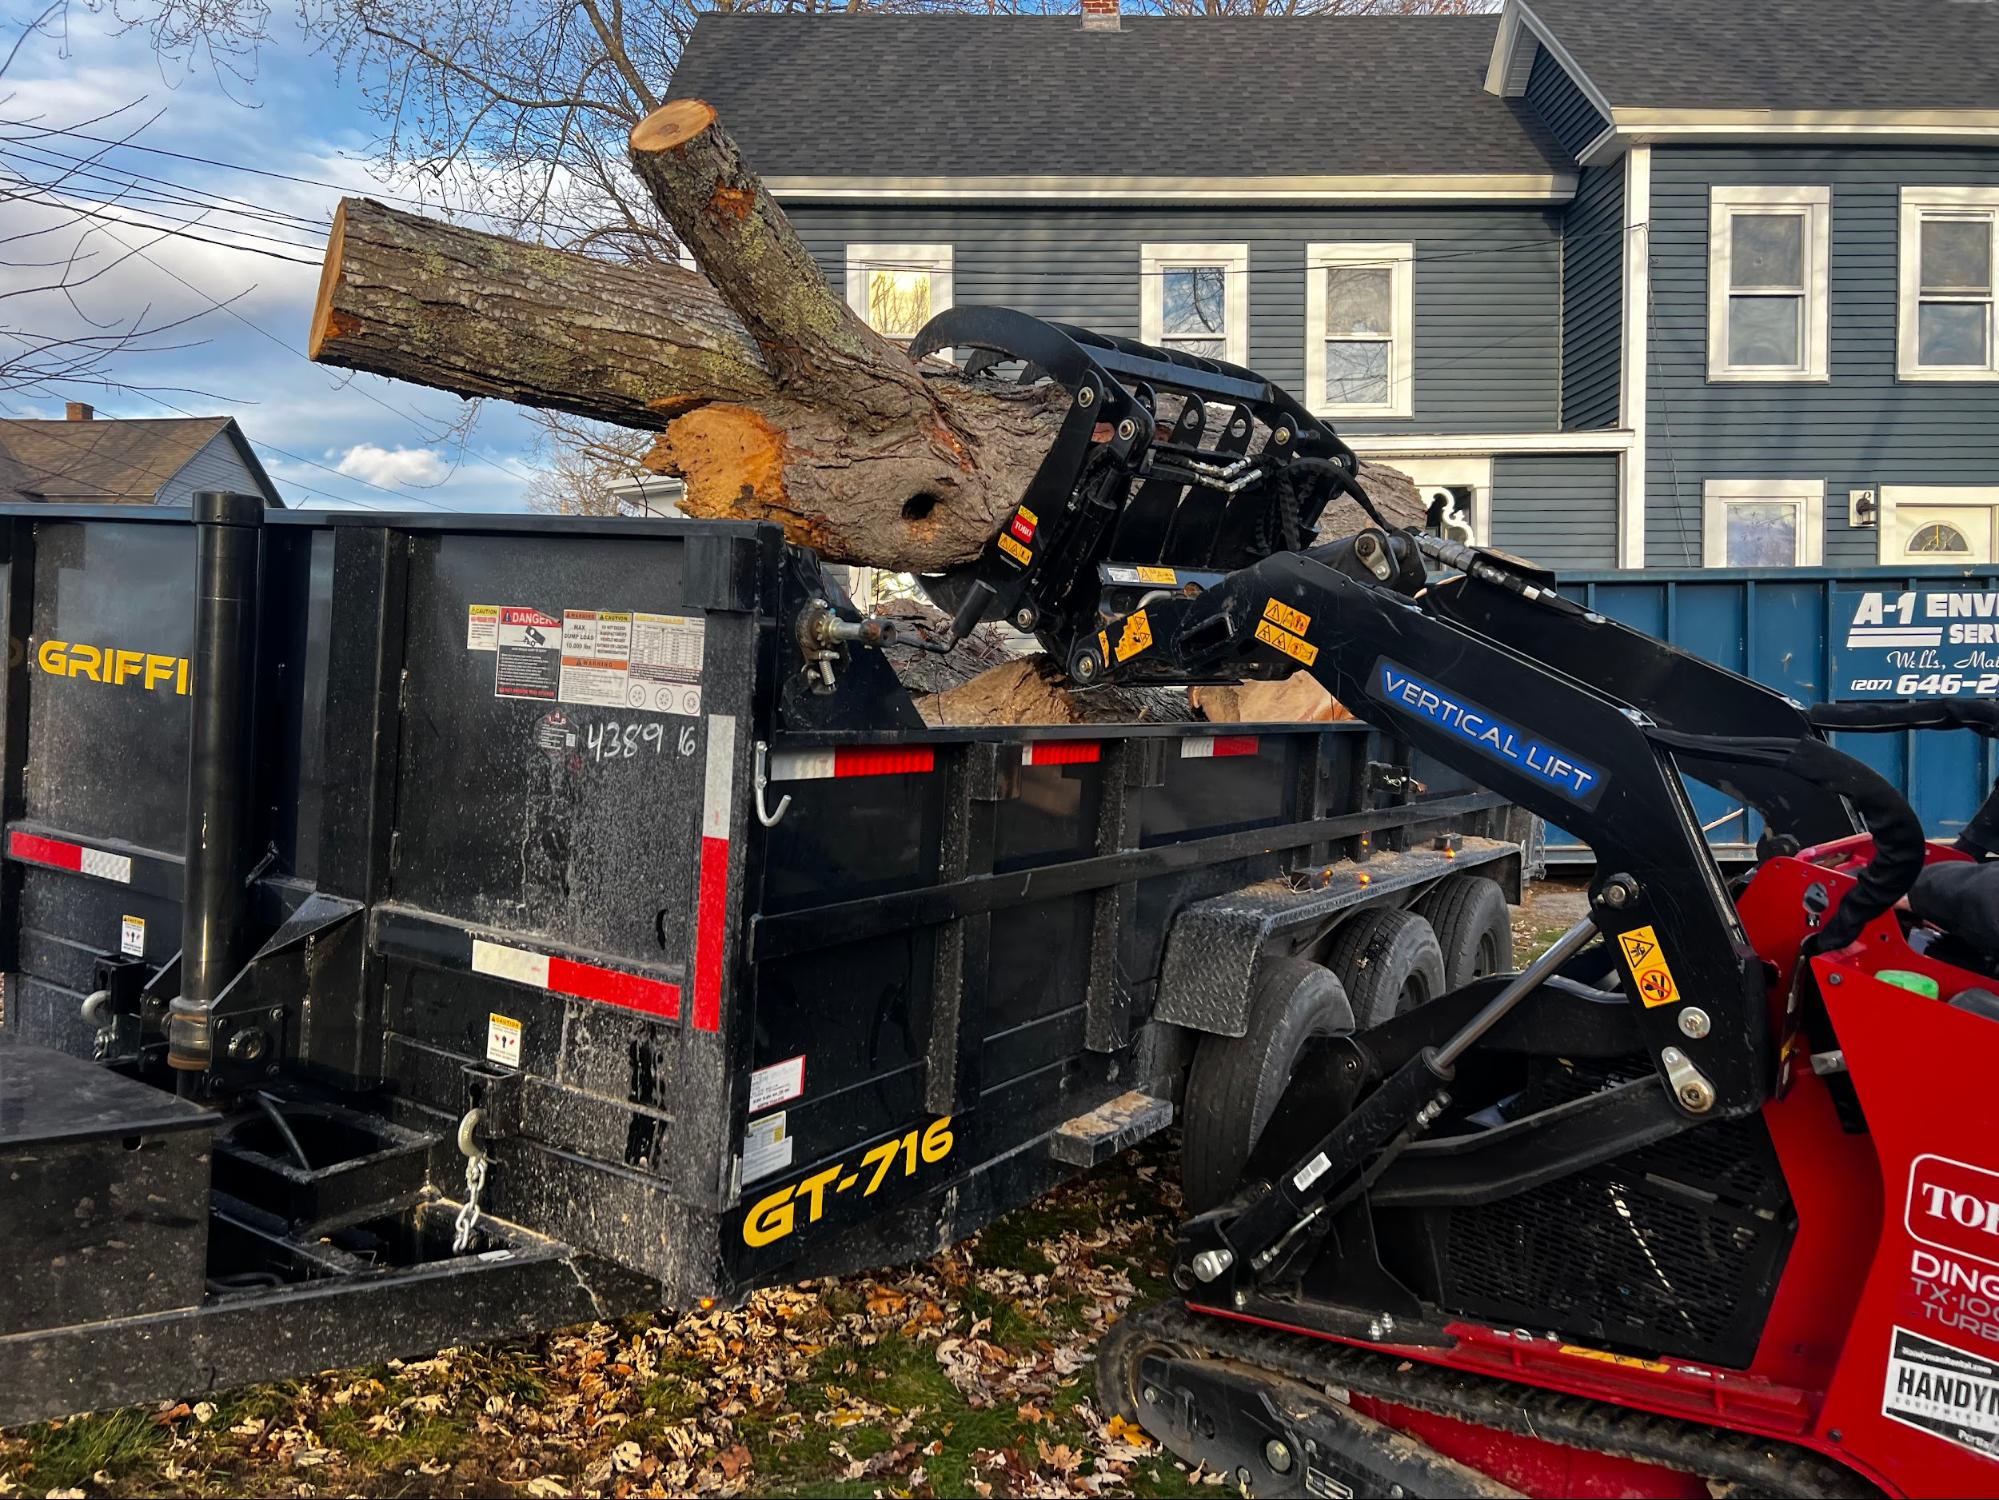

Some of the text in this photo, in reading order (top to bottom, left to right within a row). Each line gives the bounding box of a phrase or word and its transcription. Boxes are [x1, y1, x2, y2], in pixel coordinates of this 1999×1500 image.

[1852, 592, 1999, 625] A-1 ENV
[38, 640, 193, 696] GRIFFI
[1850, 673, 1999, 695] (207) 646-2
[587, 721, 664, 763] 4389
[1386, 671, 1592, 791] VERTICAL LIFT
[743, 1115, 954, 1248] GT-716
[1911, 1250, 1999, 1301] DING
[1921, 1300, 1999, 1343] TURB
